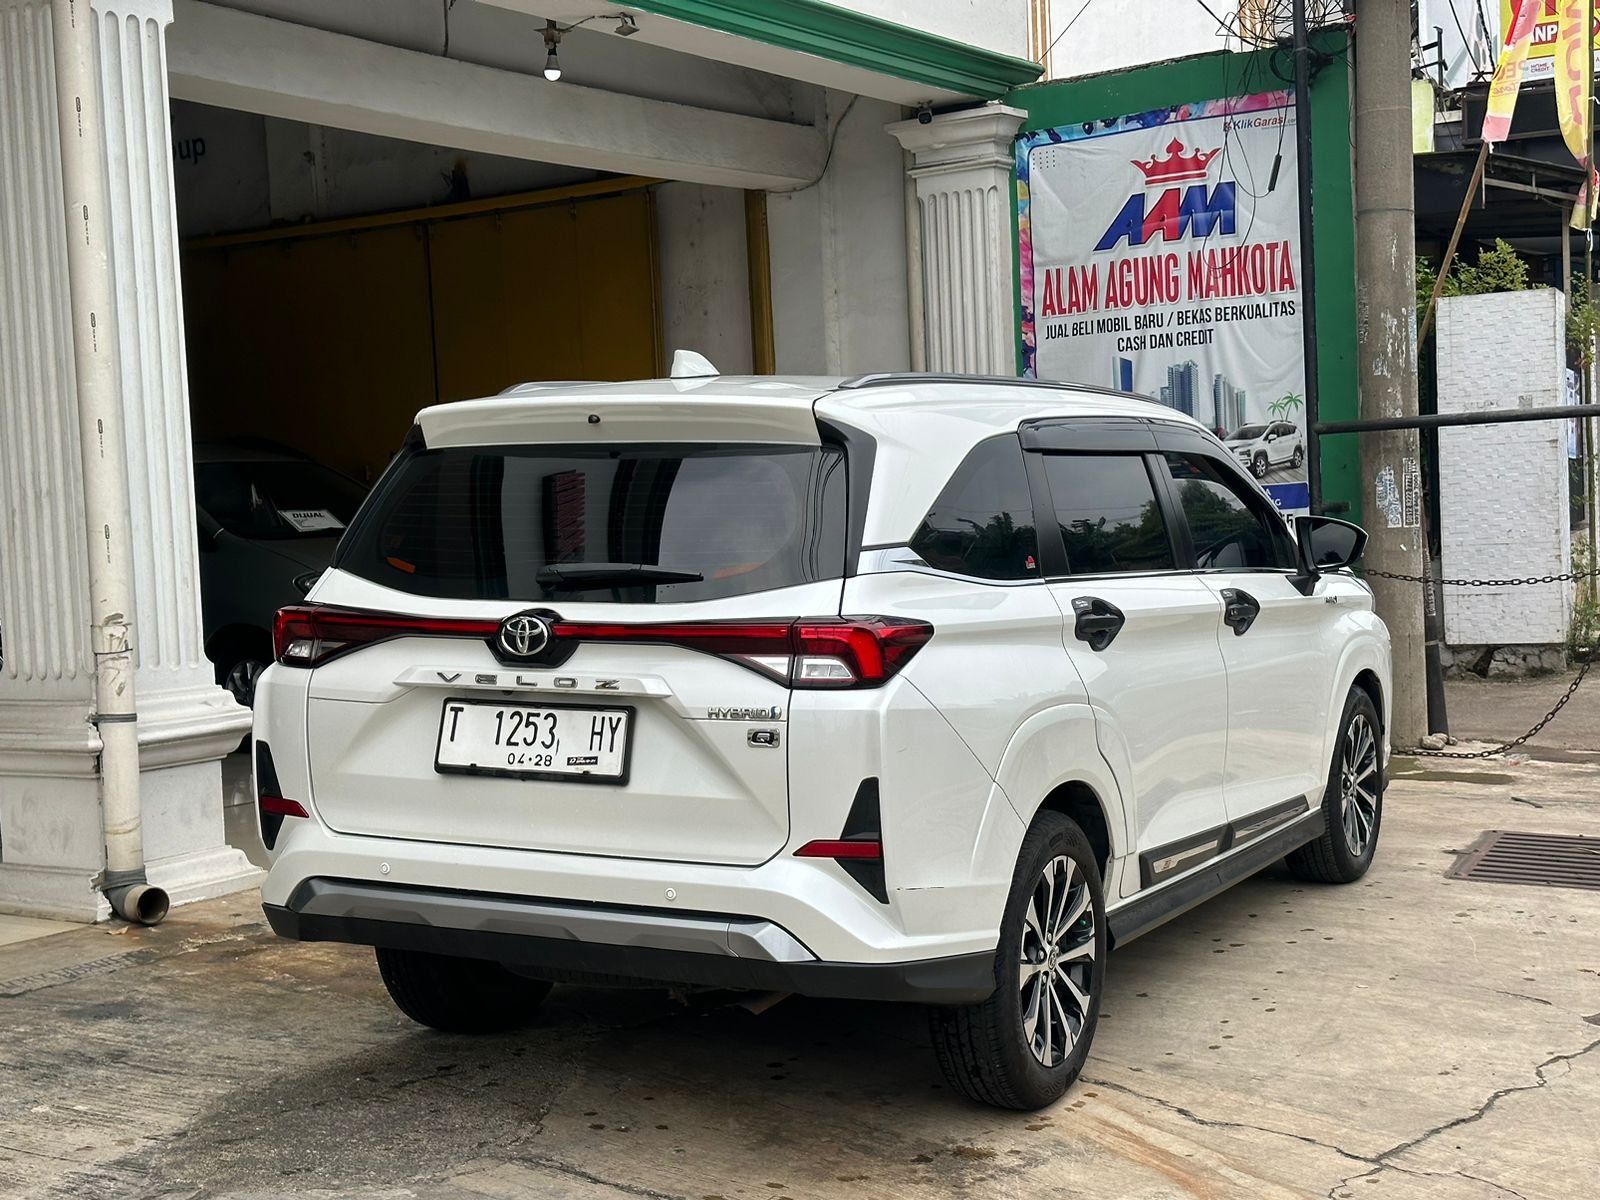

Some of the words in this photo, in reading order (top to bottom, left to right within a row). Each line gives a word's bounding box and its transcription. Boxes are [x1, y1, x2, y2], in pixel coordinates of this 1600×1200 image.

[1093, 181, 1236, 251] AAM
[1041, 263, 1098, 317] ALAM
[1104, 252, 1180, 309] AGUNG
[1187, 240, 1295, 300] MAHKOTA
[1045, 323, 1070, 340] JUAL
[1072, 320, 1094, 337] BELI
[1096, 316, 1132, 334] MOBIL
[1134, 312, 1164, 330] BARU
[1177, 307, 1212, 326] BEKAS
[1214, 300, 1296, 322] BERKUALITAS
[1117, 336, 1147, 352] CASH
[1149, 332, 1174, 349] DAN
[1176, 328, 1214, 347] CREDIT
[437, 672, 620, 690] VELOZ
[450, 706, 464, 742] T
[495, 710, 558, 749] 1253
[589, 715, 622, 752] HY
[707, 706, 769, 719] HYBRID
